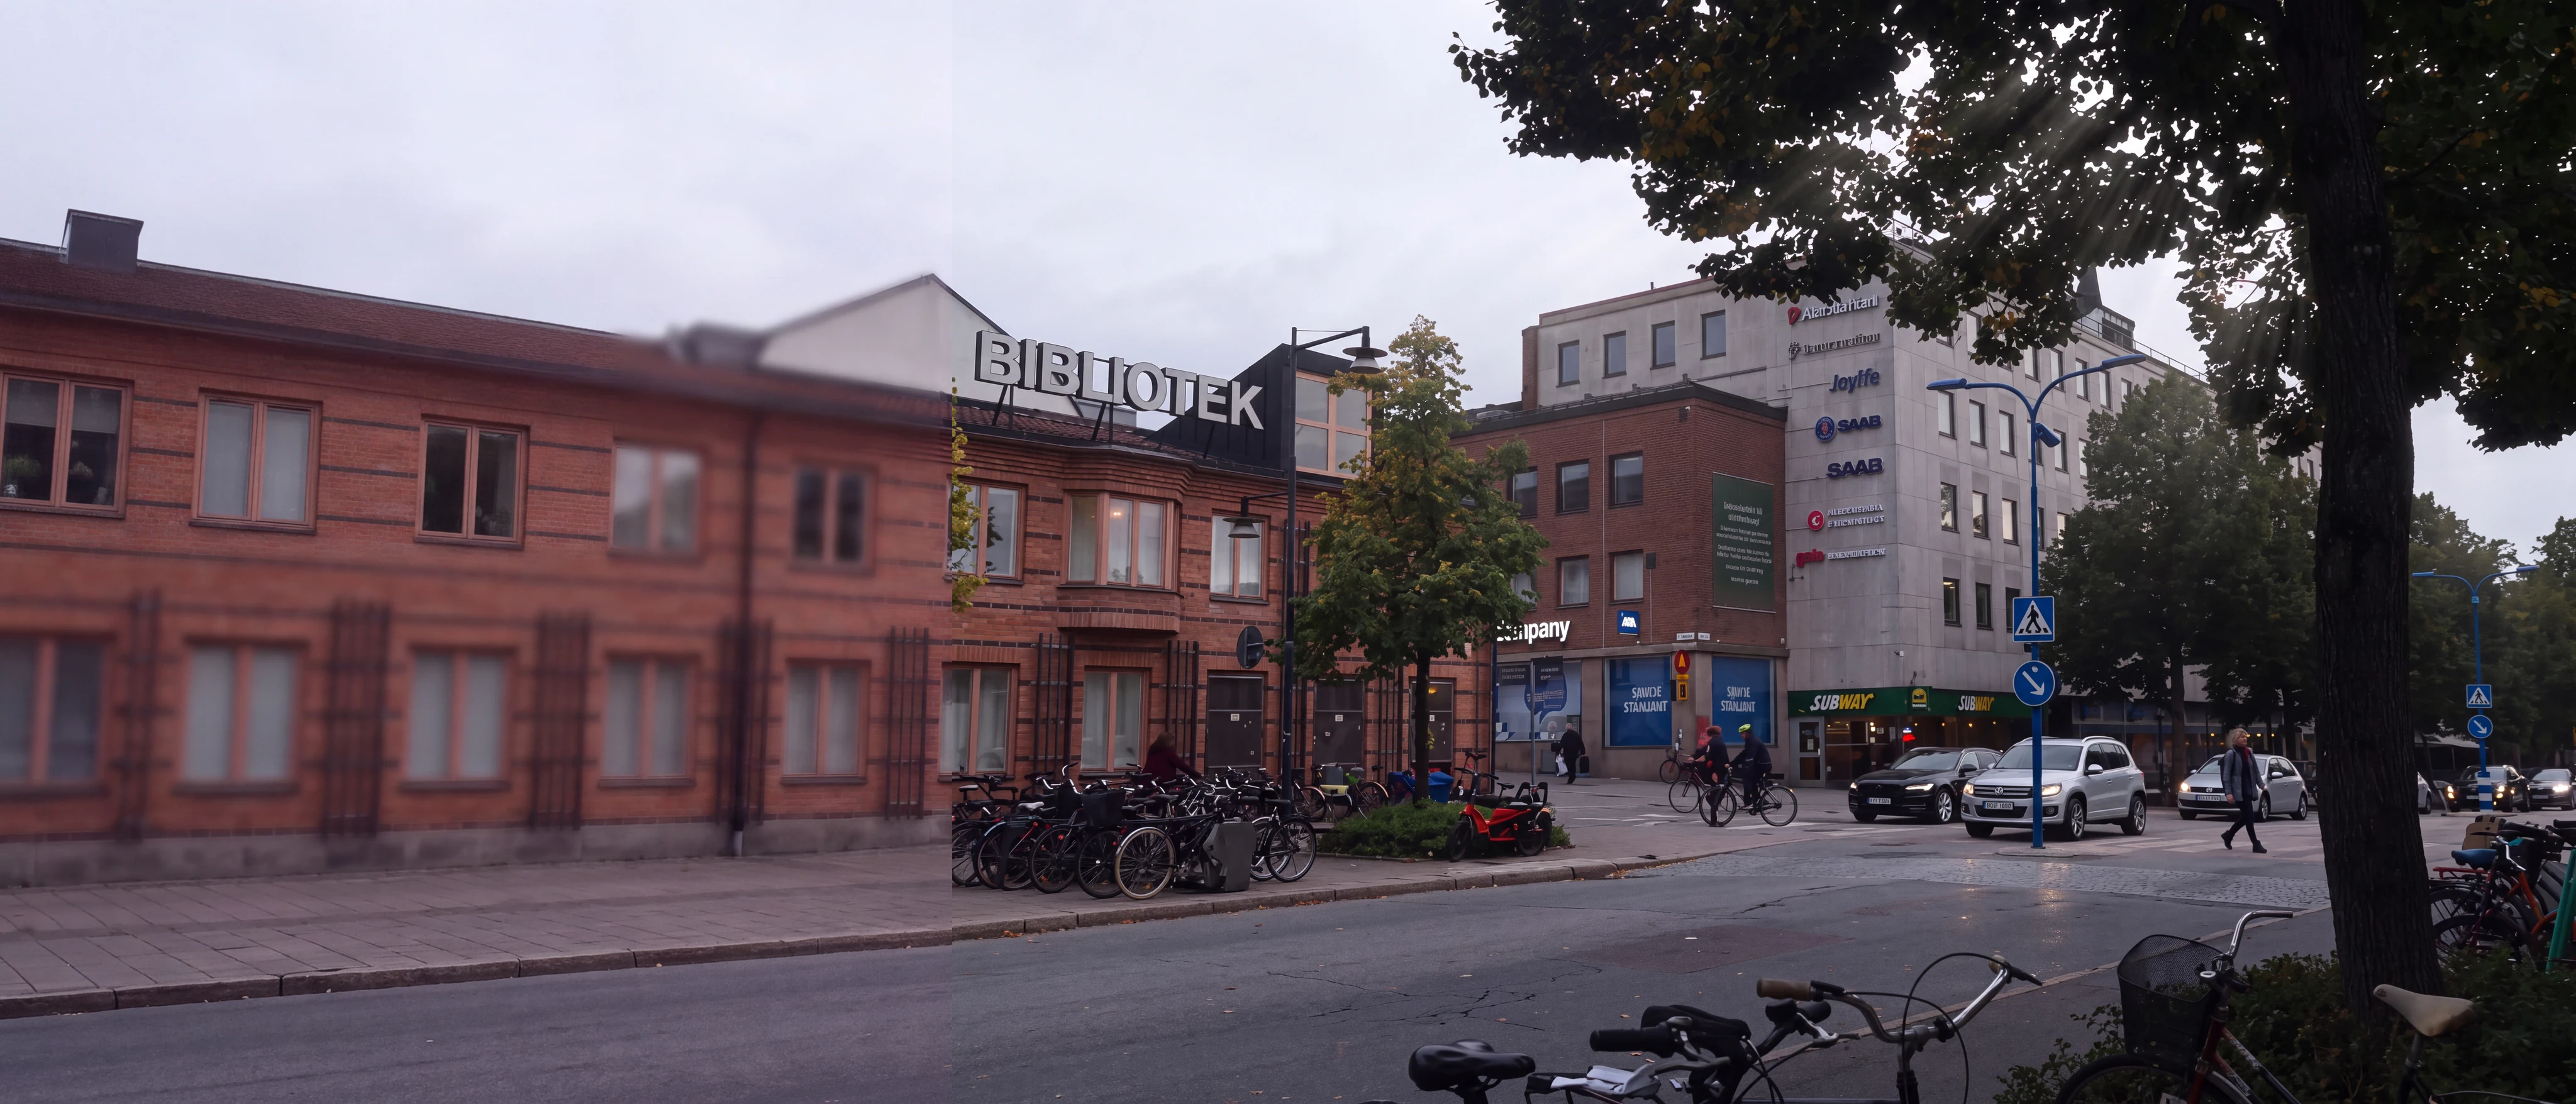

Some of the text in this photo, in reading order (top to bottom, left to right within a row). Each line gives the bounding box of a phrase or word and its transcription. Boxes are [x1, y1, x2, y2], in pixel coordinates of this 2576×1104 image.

[974, 329, 1264, 431] BIBLIOTEK
[1837, 415, 1882, 433] SAAB
[1826, 457, 1884, 479] SAAB
[1809, 692, 1875, 712] SUBWAY
[1957, 695, 1995, 712] SUBWAY
